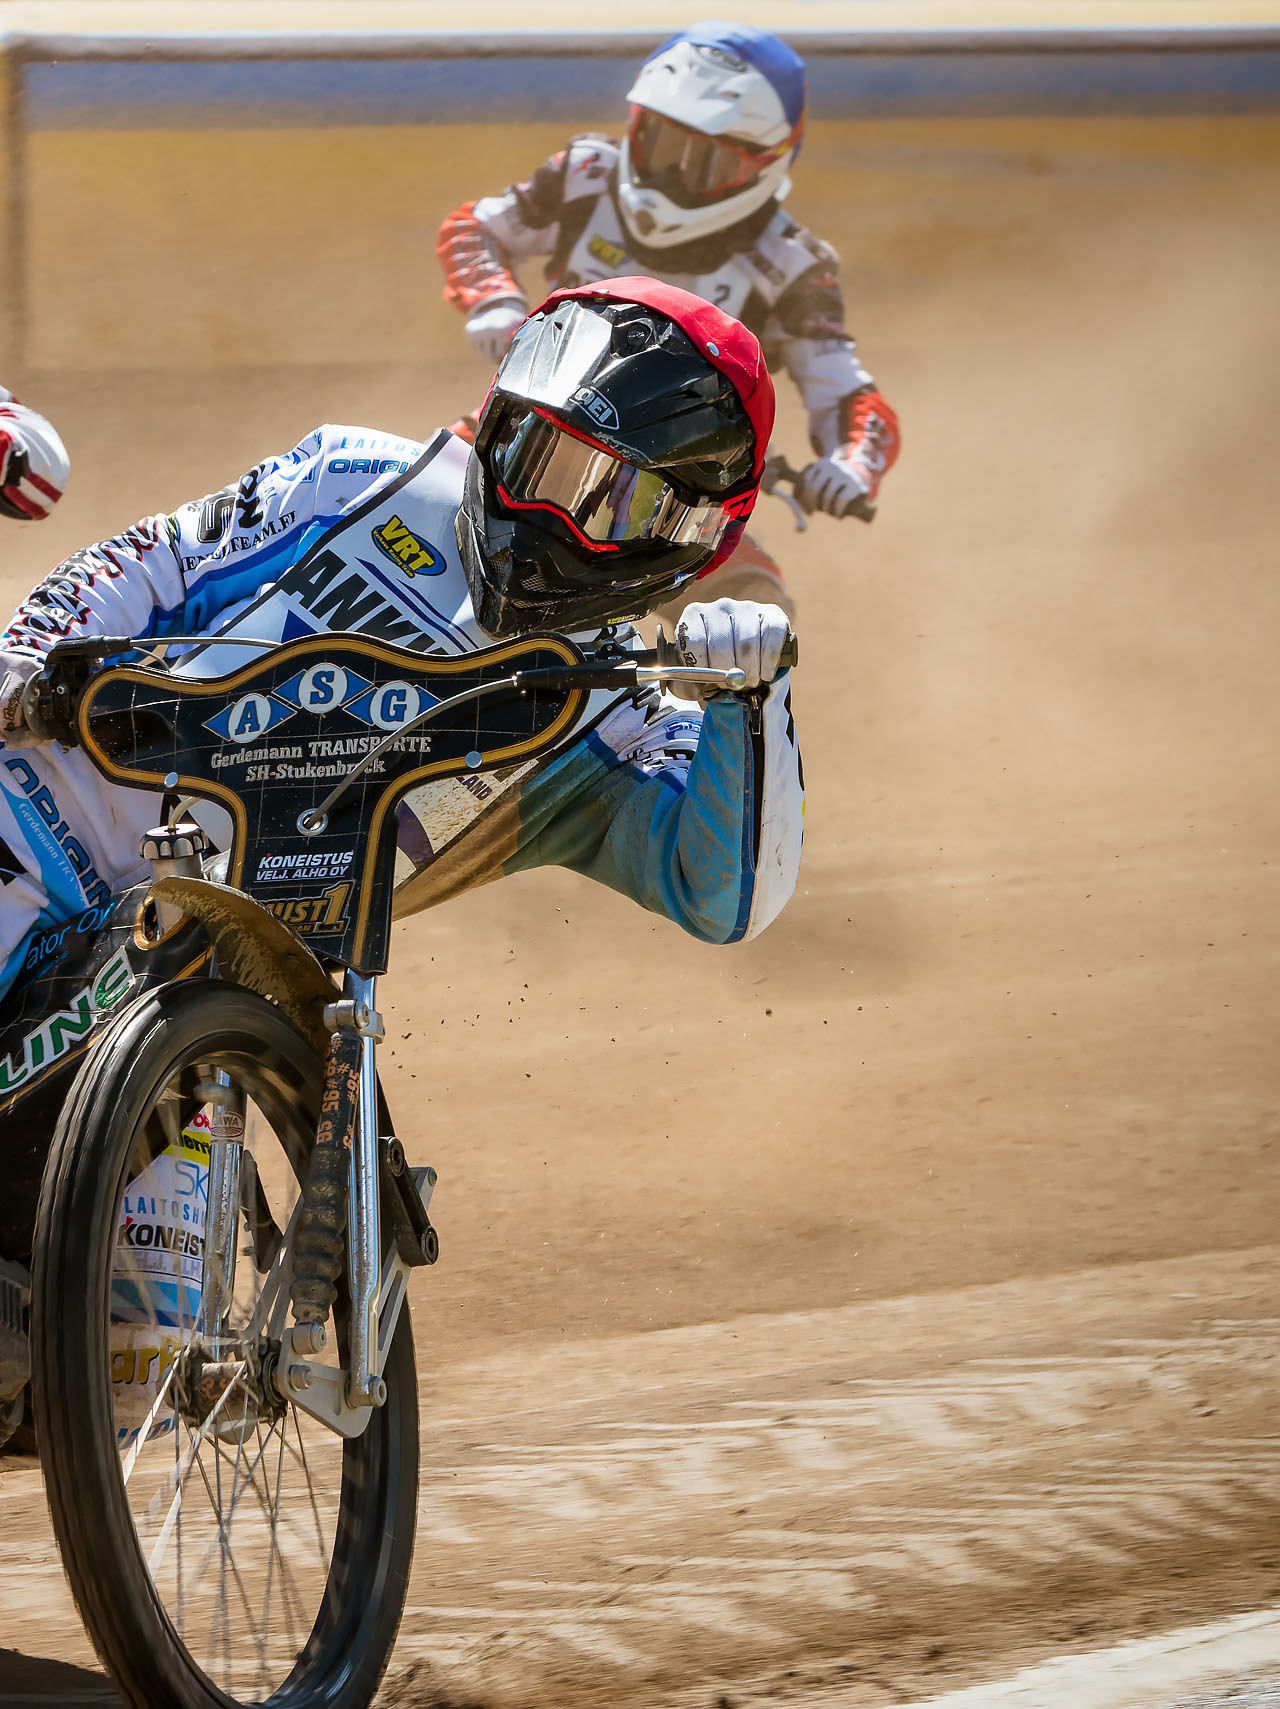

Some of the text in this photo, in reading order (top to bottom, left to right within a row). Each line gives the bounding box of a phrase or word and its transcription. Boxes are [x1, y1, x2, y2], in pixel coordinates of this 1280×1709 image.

[574, 387, 613, 423] OEI
[340, 436, 420, 457] LAITOS
[328, 458, 413, 474] ORIGI
[381, 516, 435, 571] VRT
[211, 744, 303, 769] Gerdemann
[245, 757, 386, 782] SH-Stukenbrck
[258, 851, 354, 869] KONEISTUS
[292, 867, 324, 879] ALHO
[324, 866, 349, 877] OY
[266, 883, 350, 925] UST1
[26, 902, 115, 970] ator Oy
